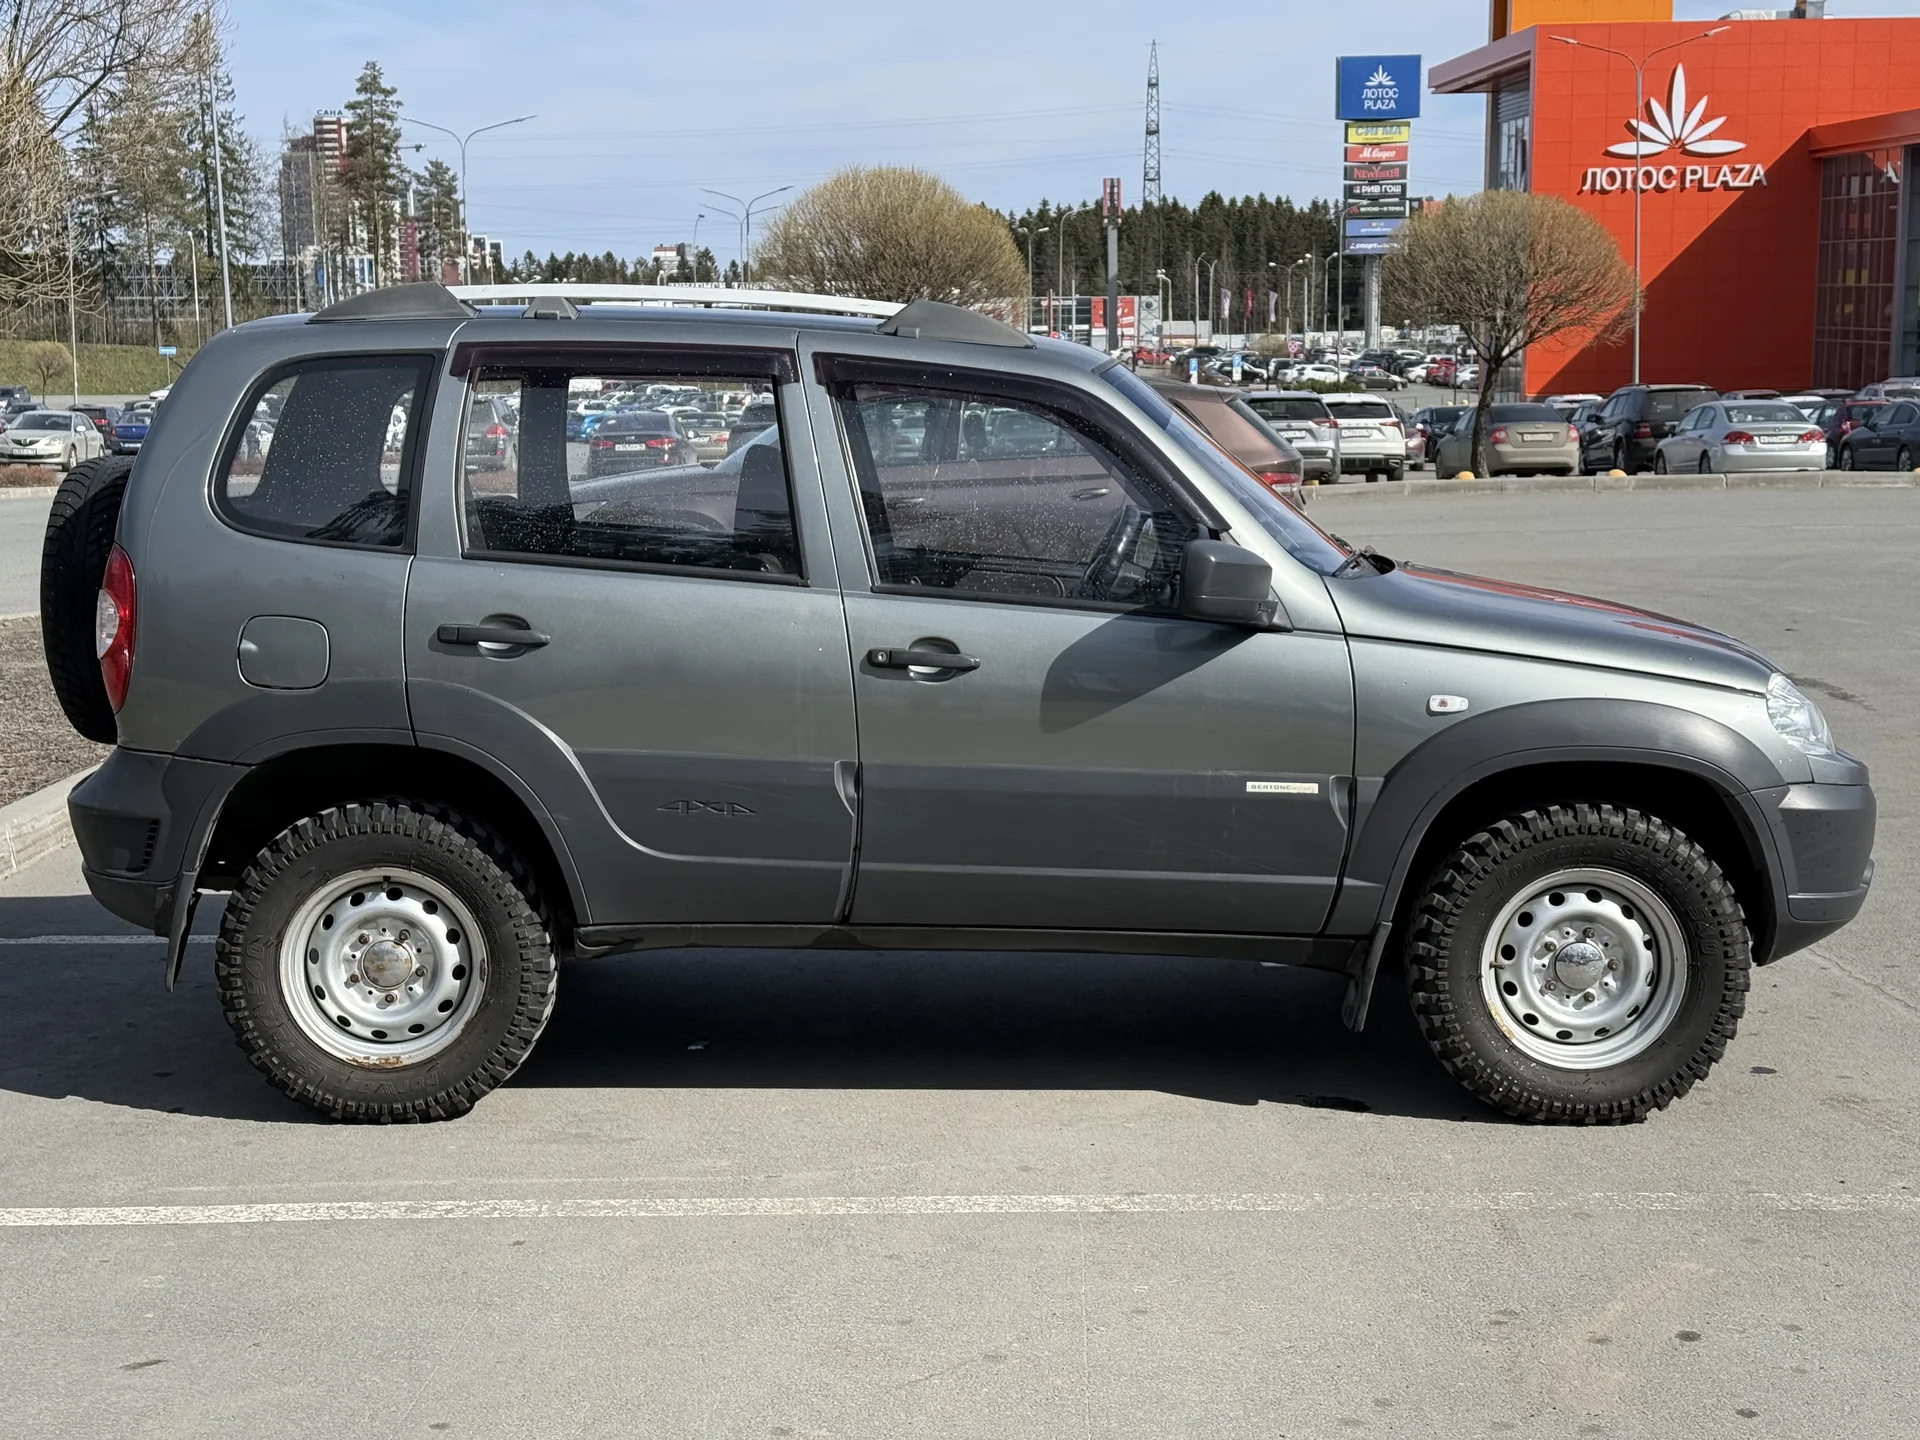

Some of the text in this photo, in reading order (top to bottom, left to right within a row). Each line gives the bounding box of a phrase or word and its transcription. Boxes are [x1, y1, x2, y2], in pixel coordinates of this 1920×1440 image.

[1361, 87, 1400, 99] ЛОТОС
[1363, 99, 1397, 110] PLAZA
[1582, 163, 1768, 191] ЛОТОС PLAZA
[1361, 184, 1402, 193] РИВ ГОШ
[244, 942, 267, 996] 540
